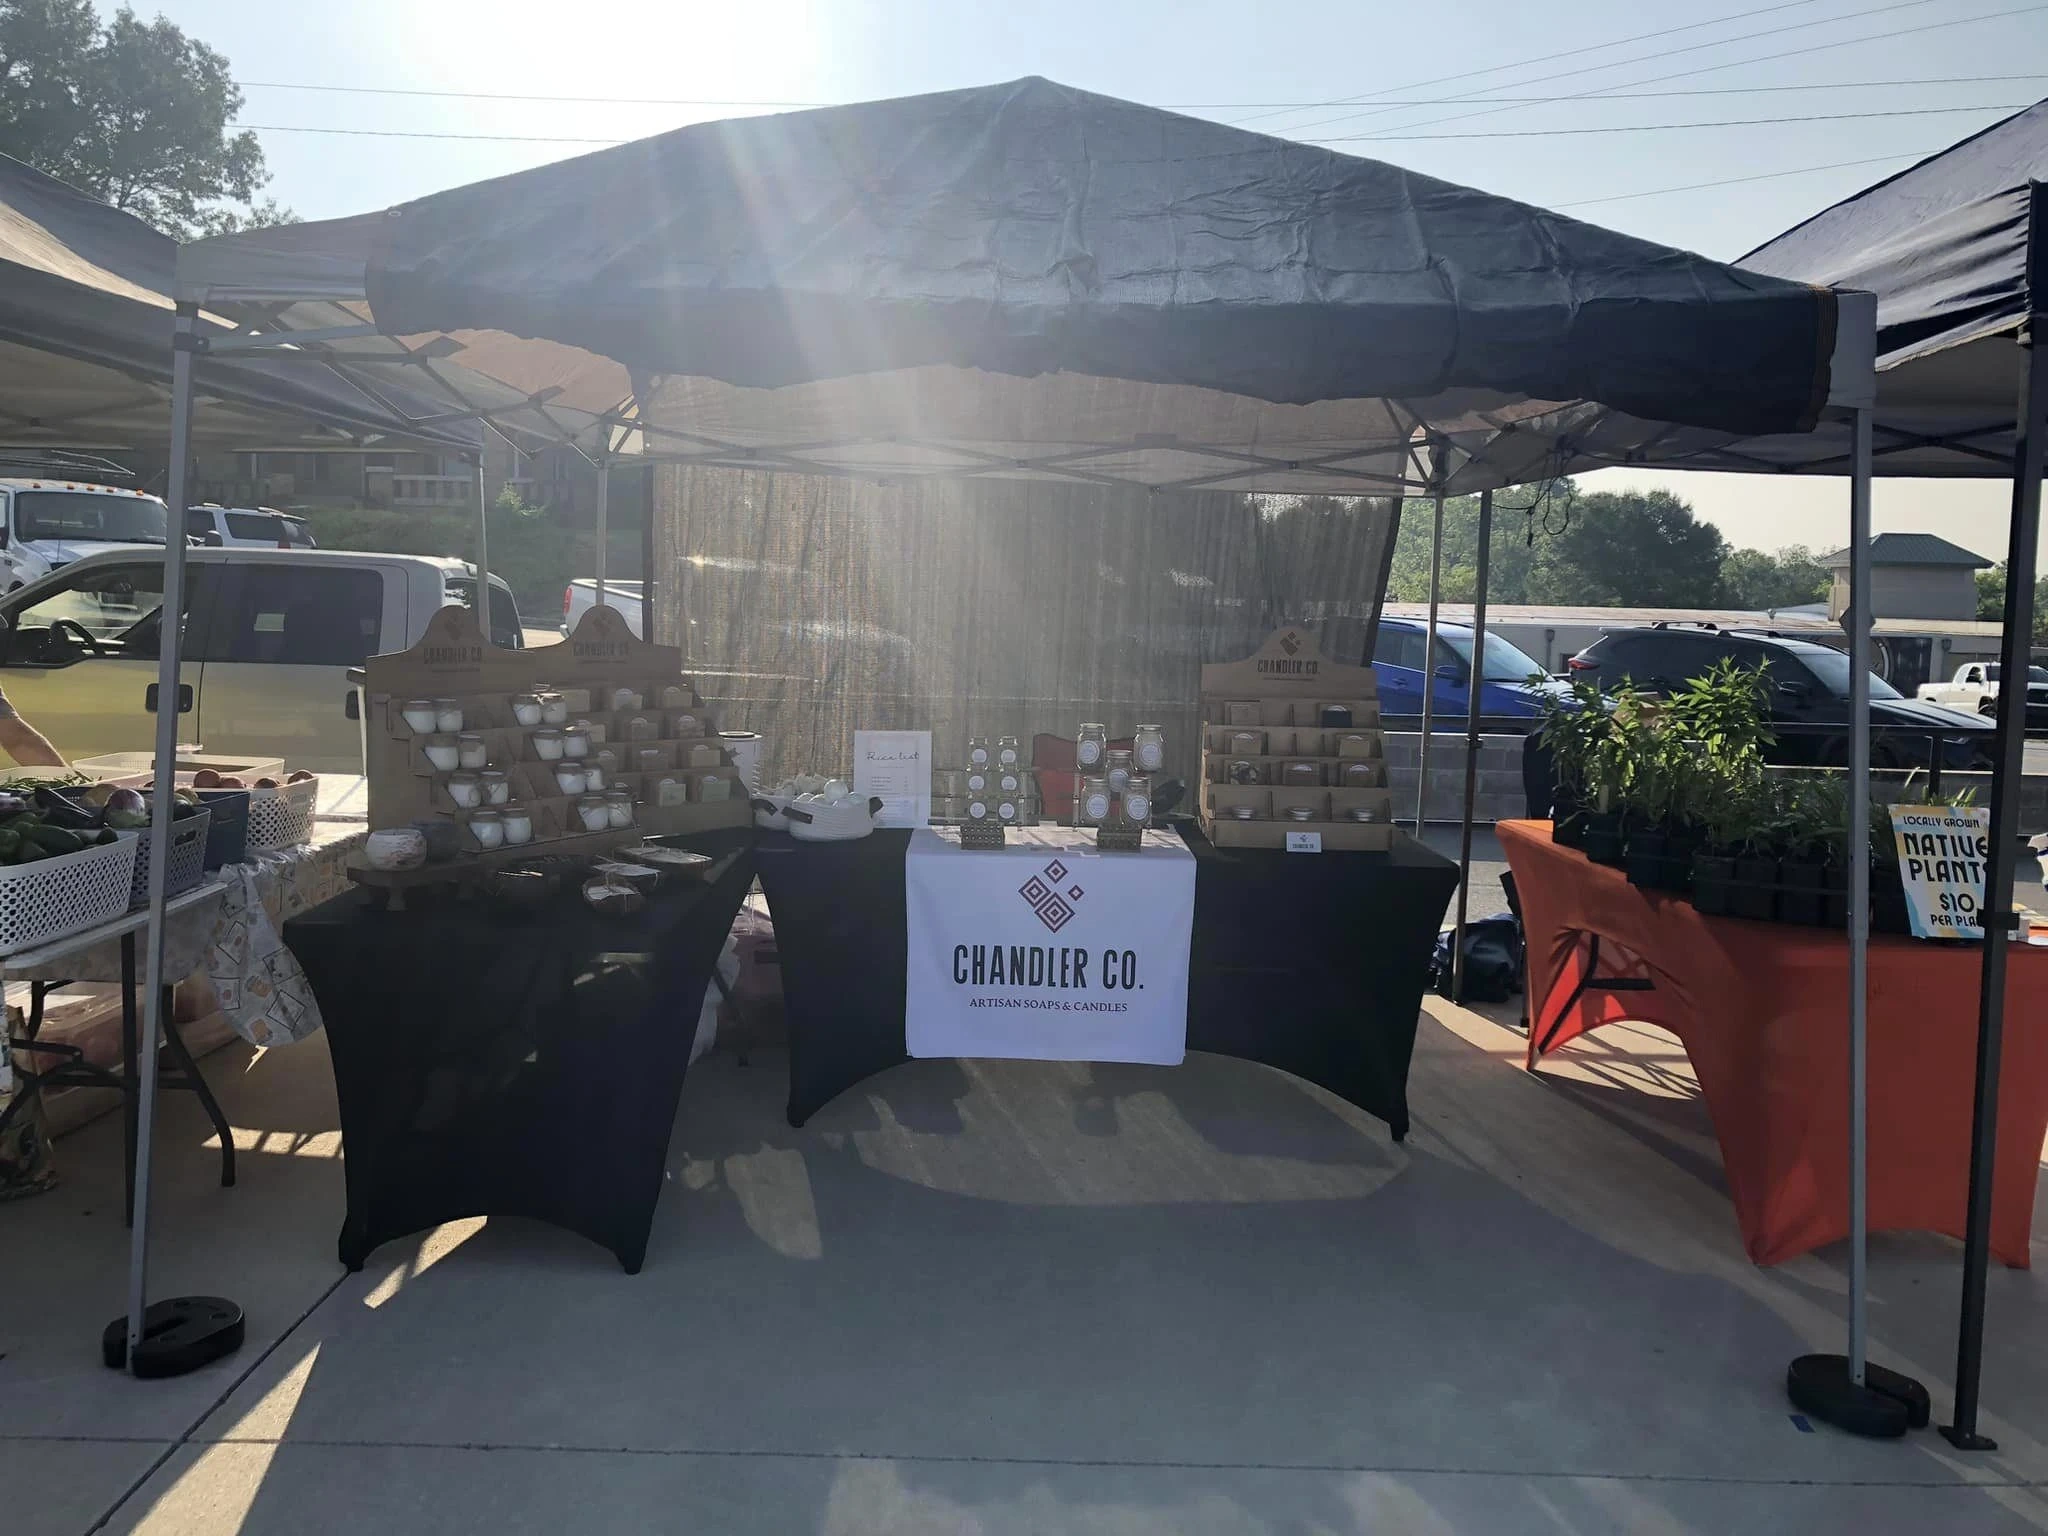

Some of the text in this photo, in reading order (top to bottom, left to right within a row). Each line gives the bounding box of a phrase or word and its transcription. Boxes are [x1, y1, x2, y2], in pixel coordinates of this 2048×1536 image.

[1257, 659, 1302, 674] CHANDLER
[1903, 816, 1980, 828] LOCALLY GROWN
[1903, 833, 1989, 858] NATIVE
[1908, 859, 1988, 884] PLANT
[1939, 893, 1975, 913] $10
[1931, 915, 1953, 926] PER
[953, 945, 1145, 990] CHANDLER CO.
[969, 998, 1127, 1012] ARTISAN SOAPS & CANDLES
